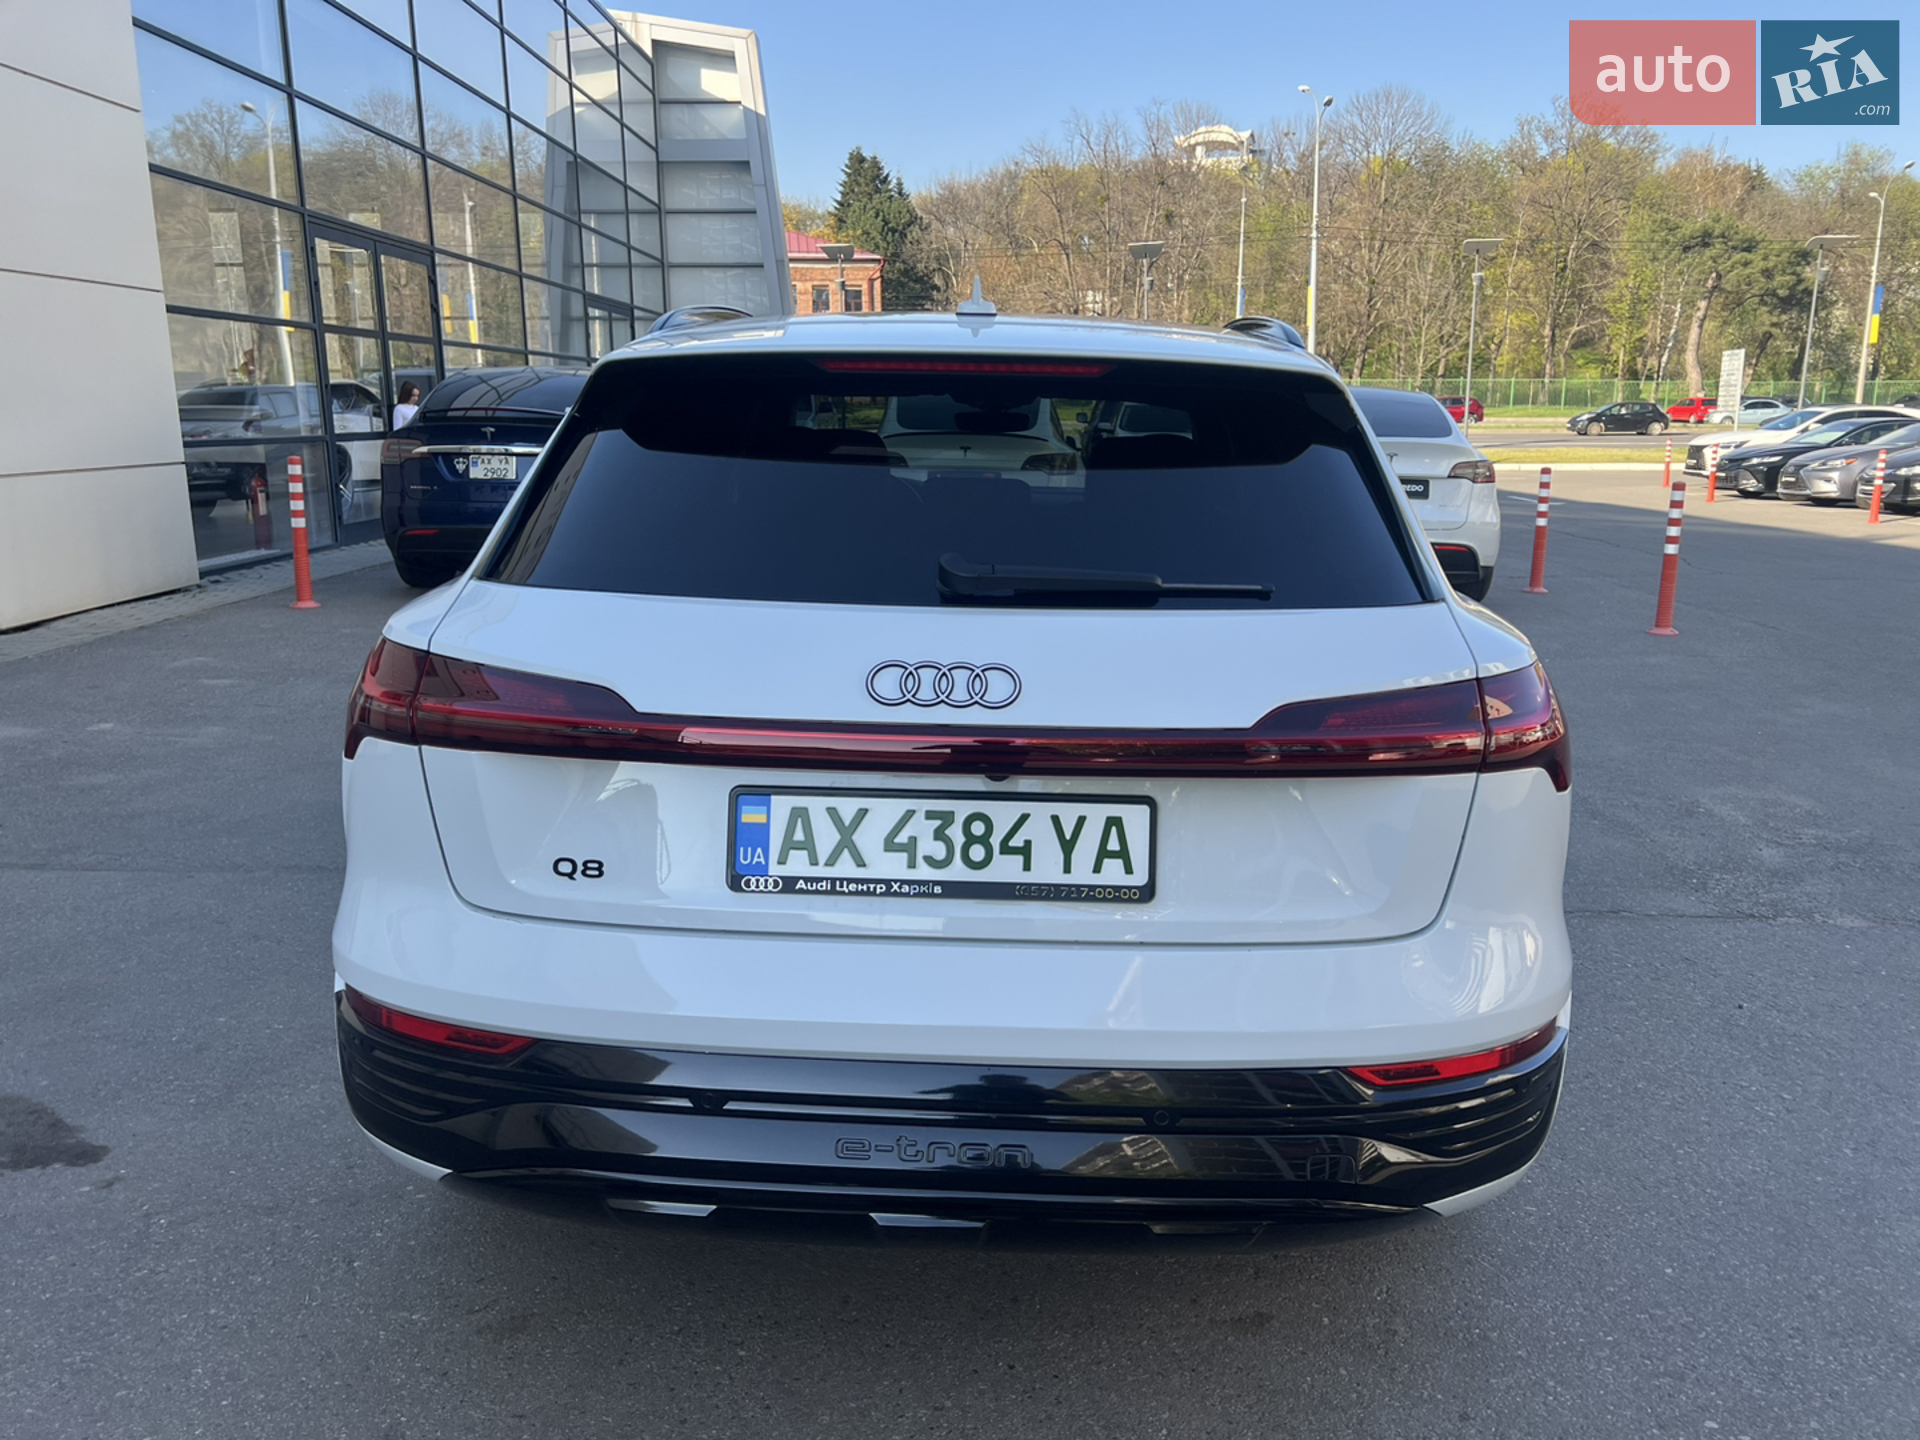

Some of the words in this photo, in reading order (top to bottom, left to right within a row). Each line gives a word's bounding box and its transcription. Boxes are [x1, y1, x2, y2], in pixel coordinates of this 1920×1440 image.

[483, 468, 509, 478] 2902
[777, 806, 869, 868] AX
[884, 809, 1033, 872] 4384
[1050, 814, 1134, 875] YA
[739, 846, 766, 865] UA
[552, 856, 605, 881] Q8
[795, 879, 831, 891] Audi
[835, 881, 886, 895] Центр
[890, 881, 943, 896] Харків
[1060, 886, 1140, 899] 717-00-00
[835, 1135, 1034, 1169] e-tron
